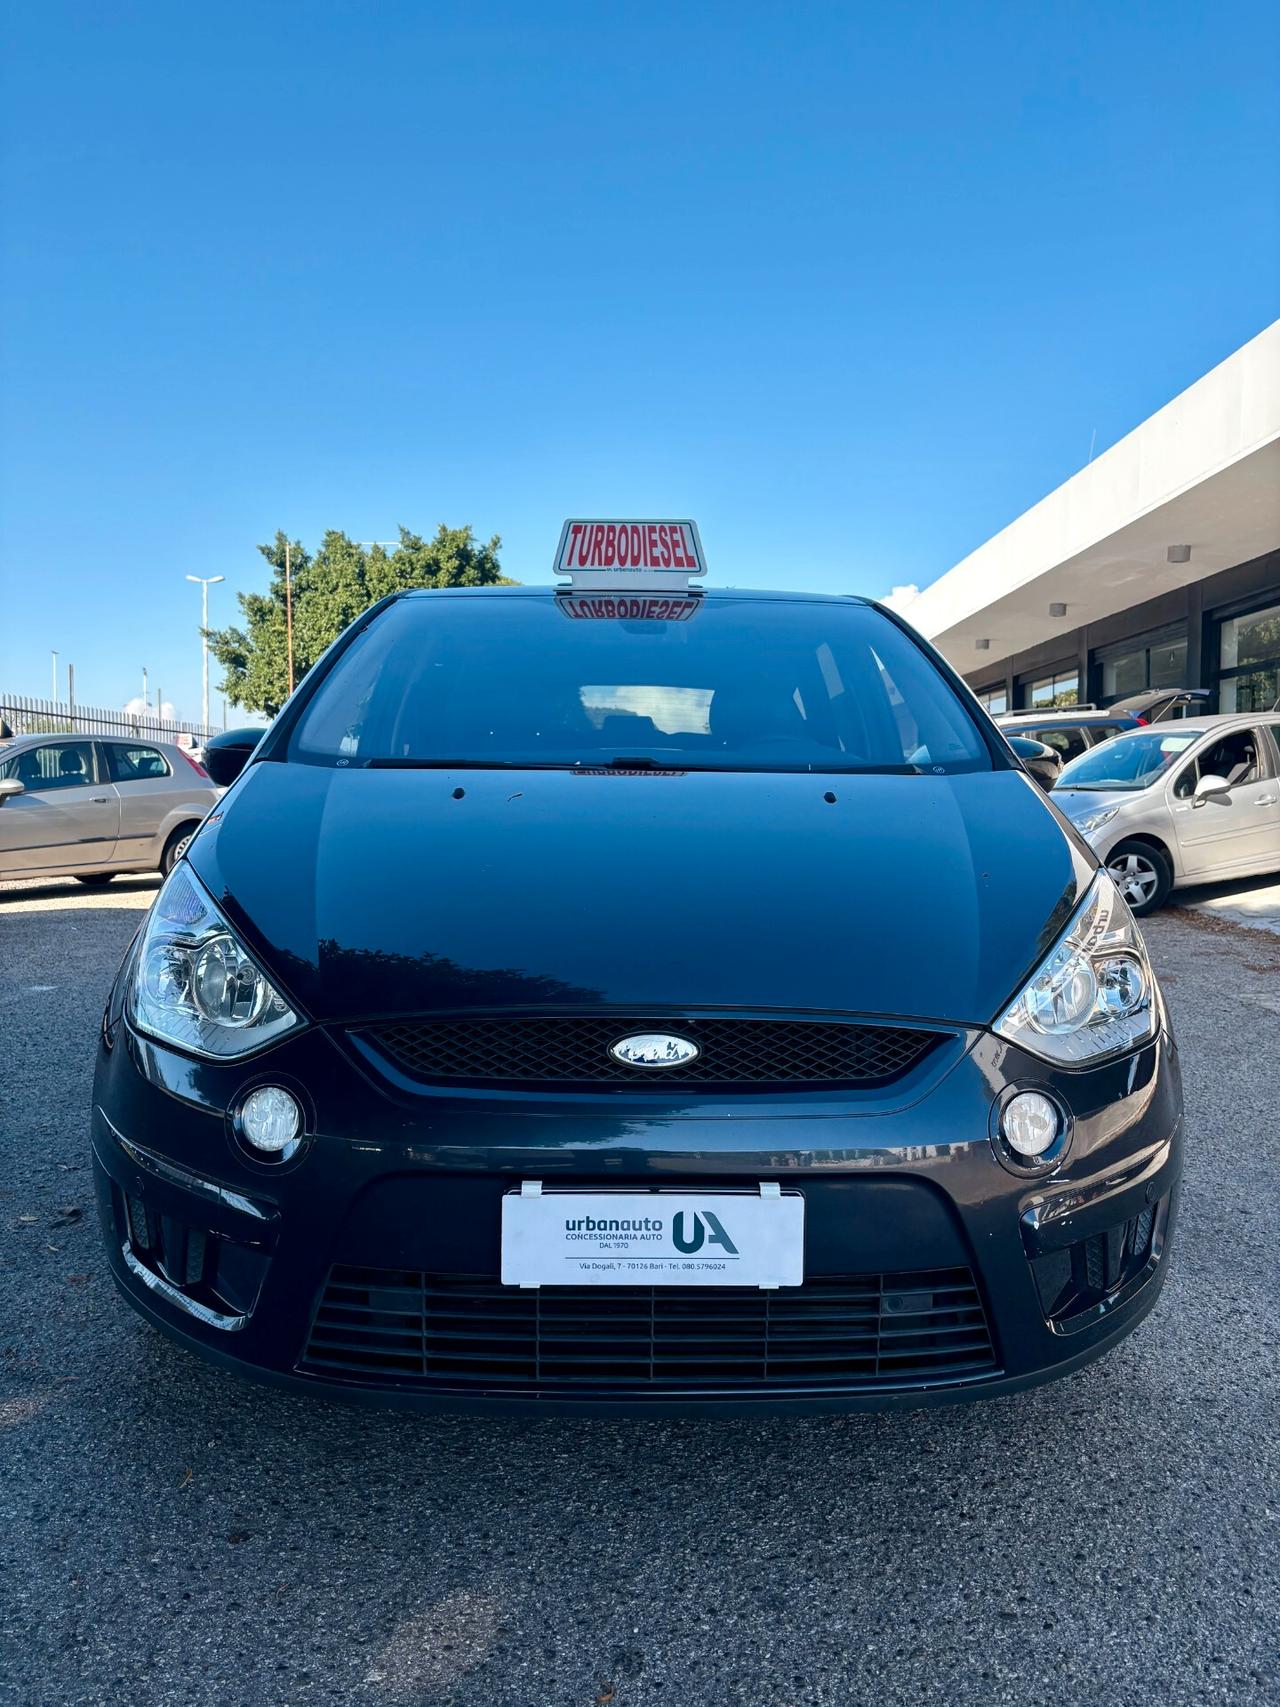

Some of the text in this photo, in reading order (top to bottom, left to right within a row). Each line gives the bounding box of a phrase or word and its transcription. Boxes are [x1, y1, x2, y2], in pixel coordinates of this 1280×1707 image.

[567, 524, 697, 568] TURBODIESEL
[565, 1215, 663, 1232] urbanauto
[565, 1232, 663, 1241] CONCESSIONARIA AUTO
[672, 1211, 740, 1254] UA
[579, 1262, 591, 1270] Via
[592, 1262, 616, 1271] Dogali,
[627, 1262, 648, 1270] 70126
[649, 1262, 664, 1270] Bari
